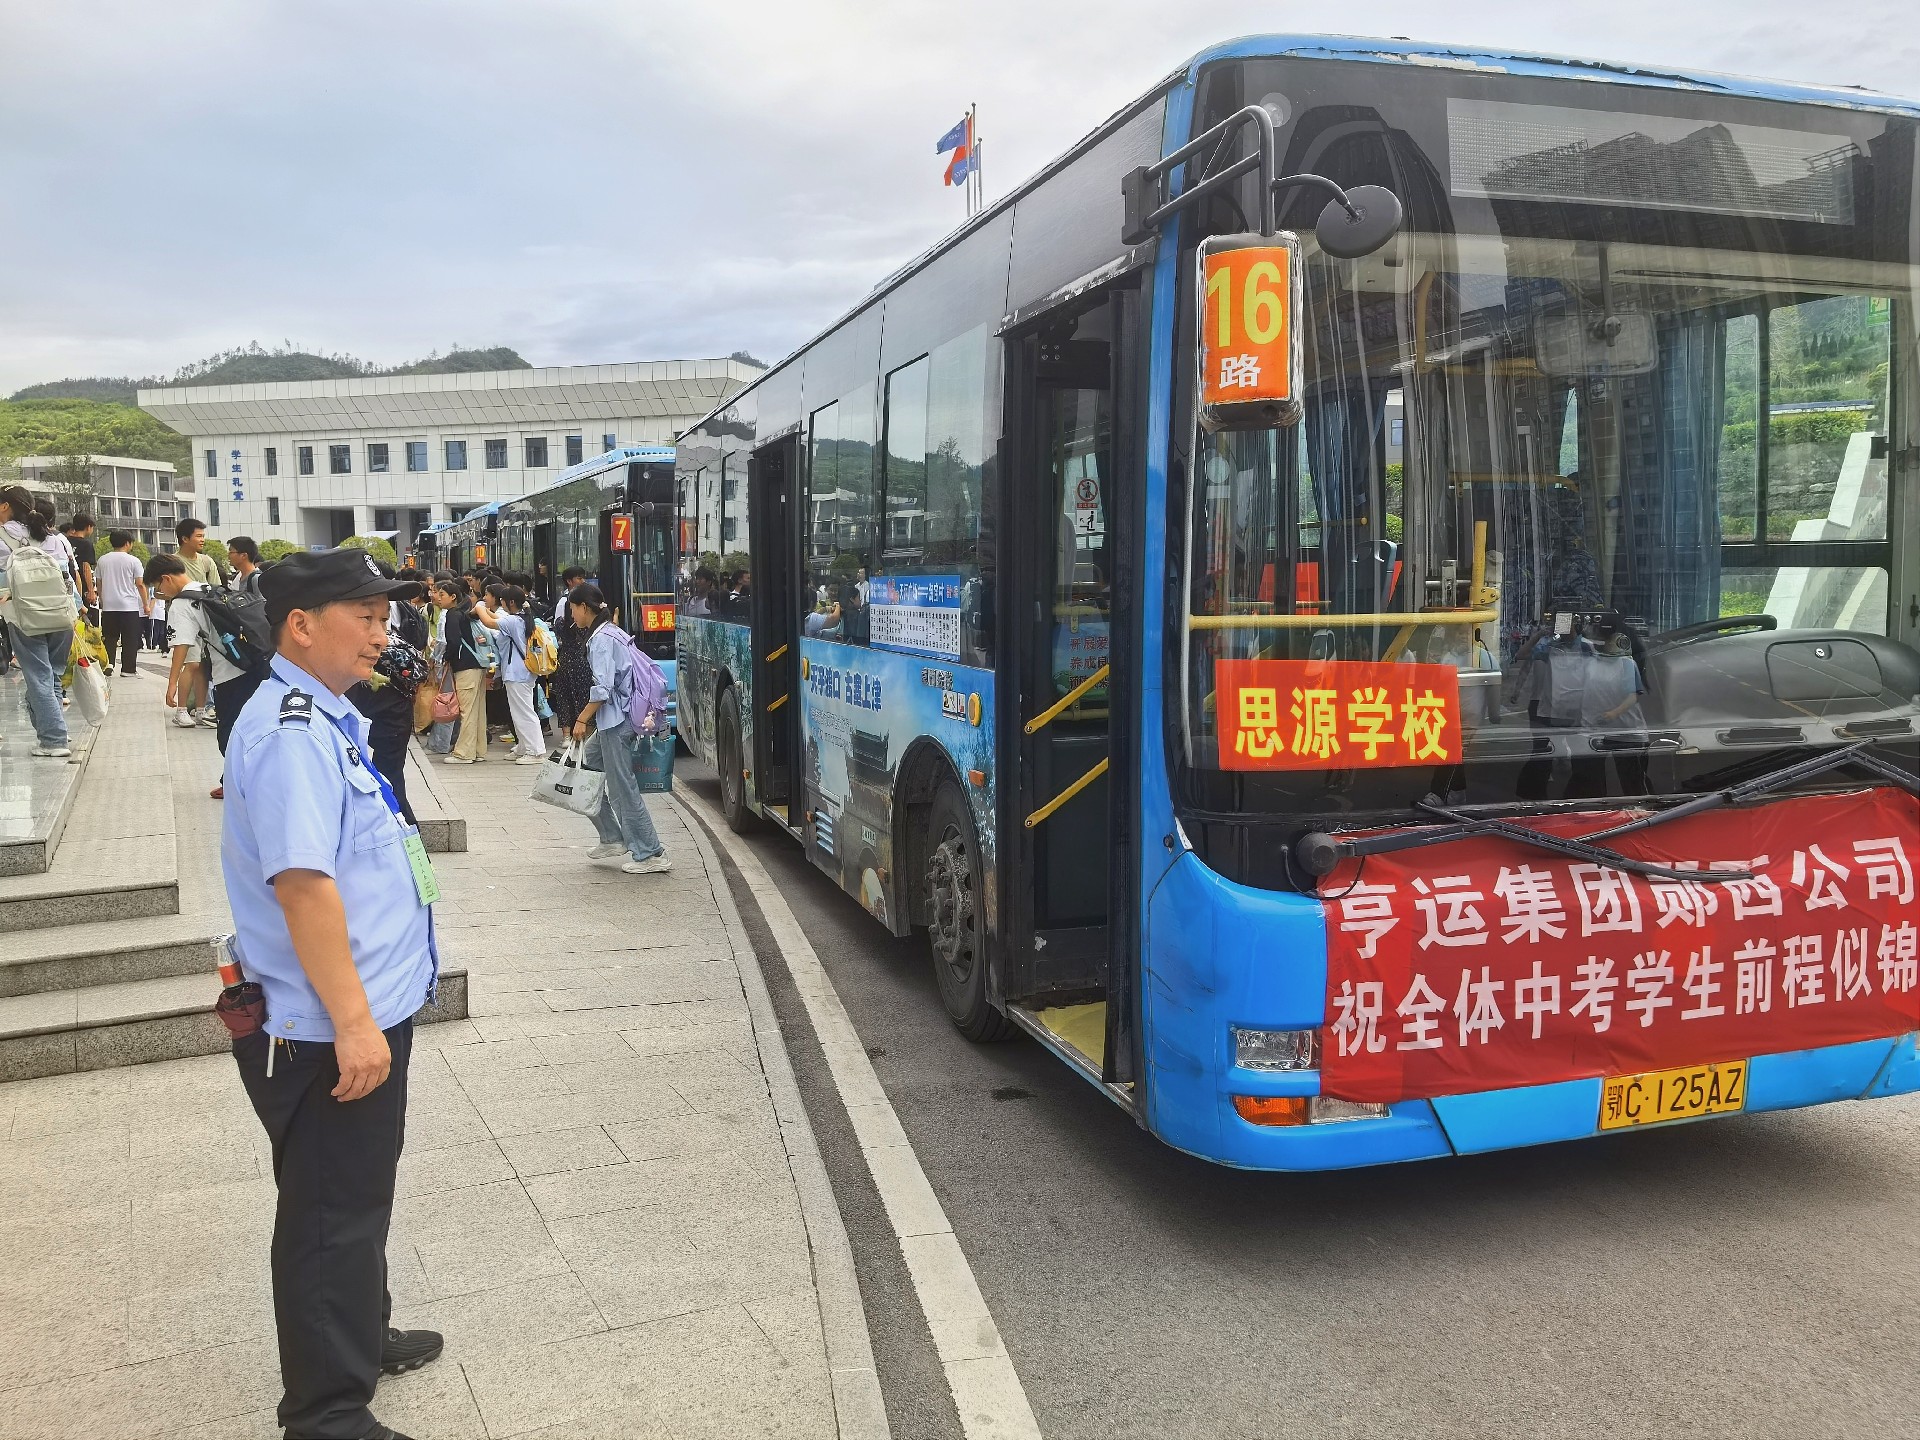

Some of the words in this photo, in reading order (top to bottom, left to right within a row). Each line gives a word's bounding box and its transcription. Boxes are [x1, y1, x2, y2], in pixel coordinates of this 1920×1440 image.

[1207, 261, 1283, 348] 16
[1219, 353, 1261, 389] 路
[231, 449, 244, 501] 学生礼堂
[475, 545, 486, 558] 10
[615, 520, 627, 539] 7
[647, 610, 674, 628] 思源
[1235, 686, 1448, 761] 思源学校
[1336, 836, 1915, 960] 亨运集团郧西公司
[1331, 920, 1919, 1057] 祝全体中考学生前程似锦
